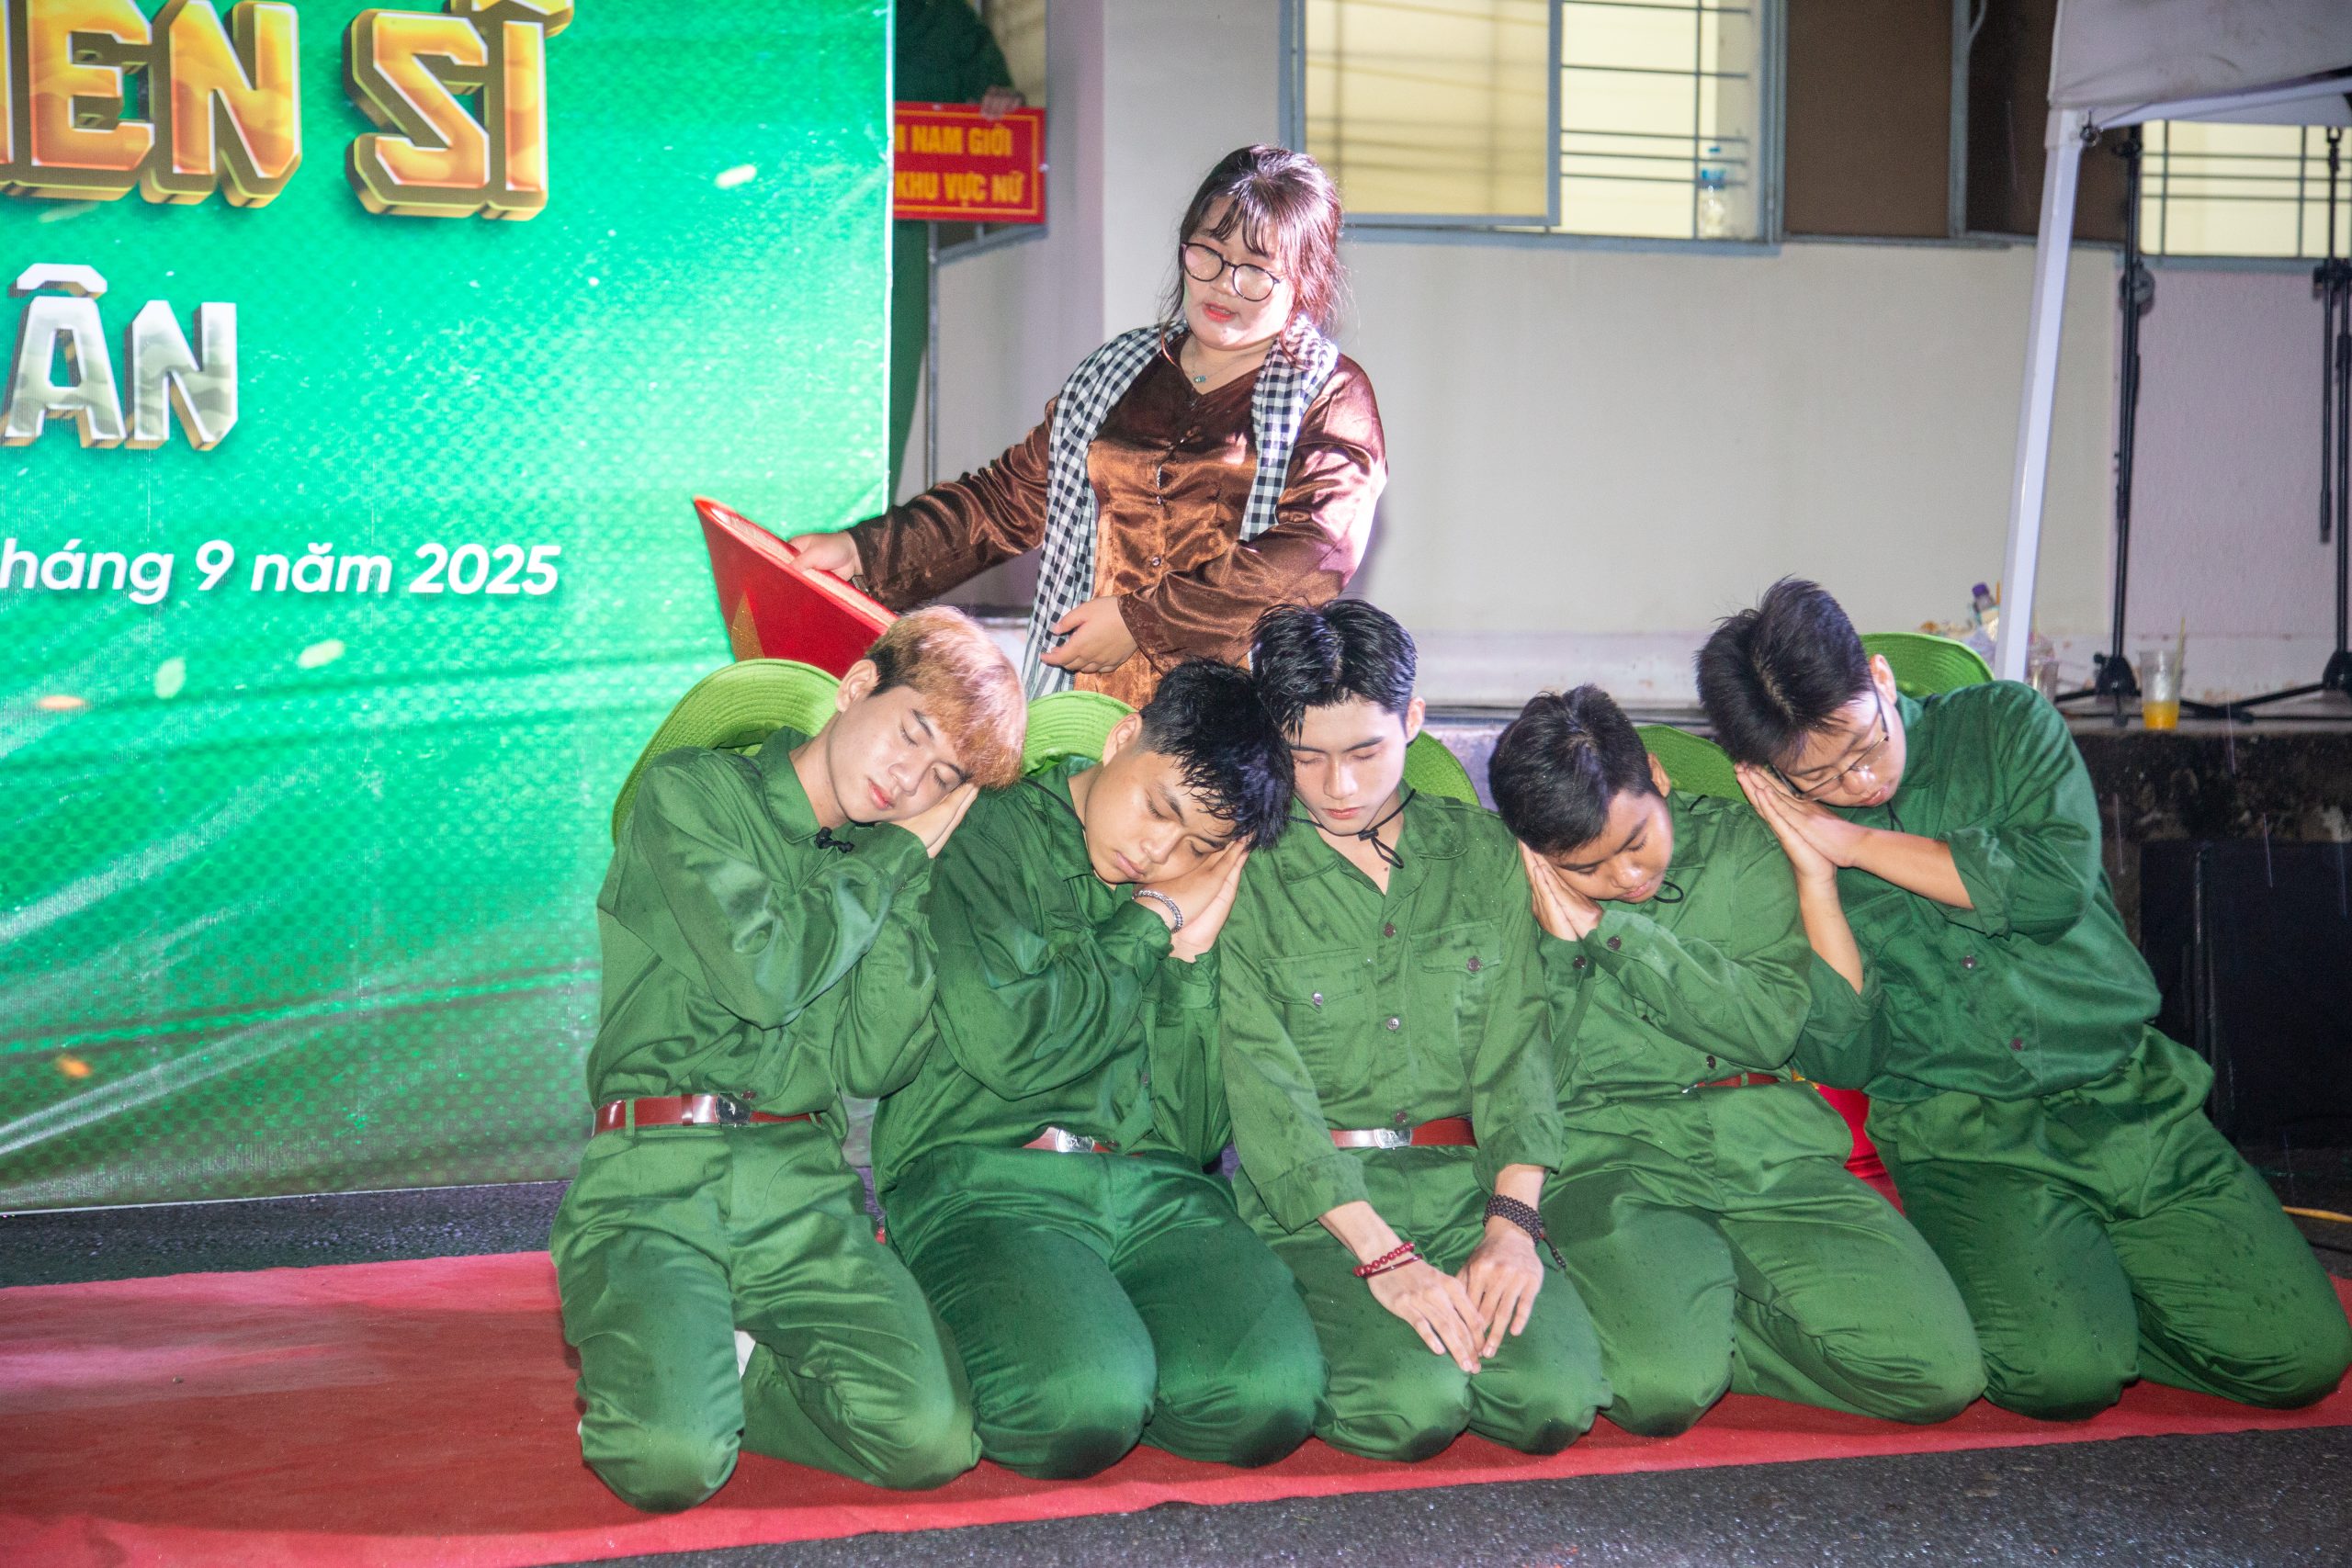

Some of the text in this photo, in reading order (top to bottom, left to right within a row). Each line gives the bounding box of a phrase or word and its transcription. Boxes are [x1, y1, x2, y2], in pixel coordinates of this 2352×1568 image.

[911, 125, 964, 154] NAM
[895, 169, 1025, 207] KHU VỰC NỮ
[0, 537, 562, 604] háng 9 năm 2025
